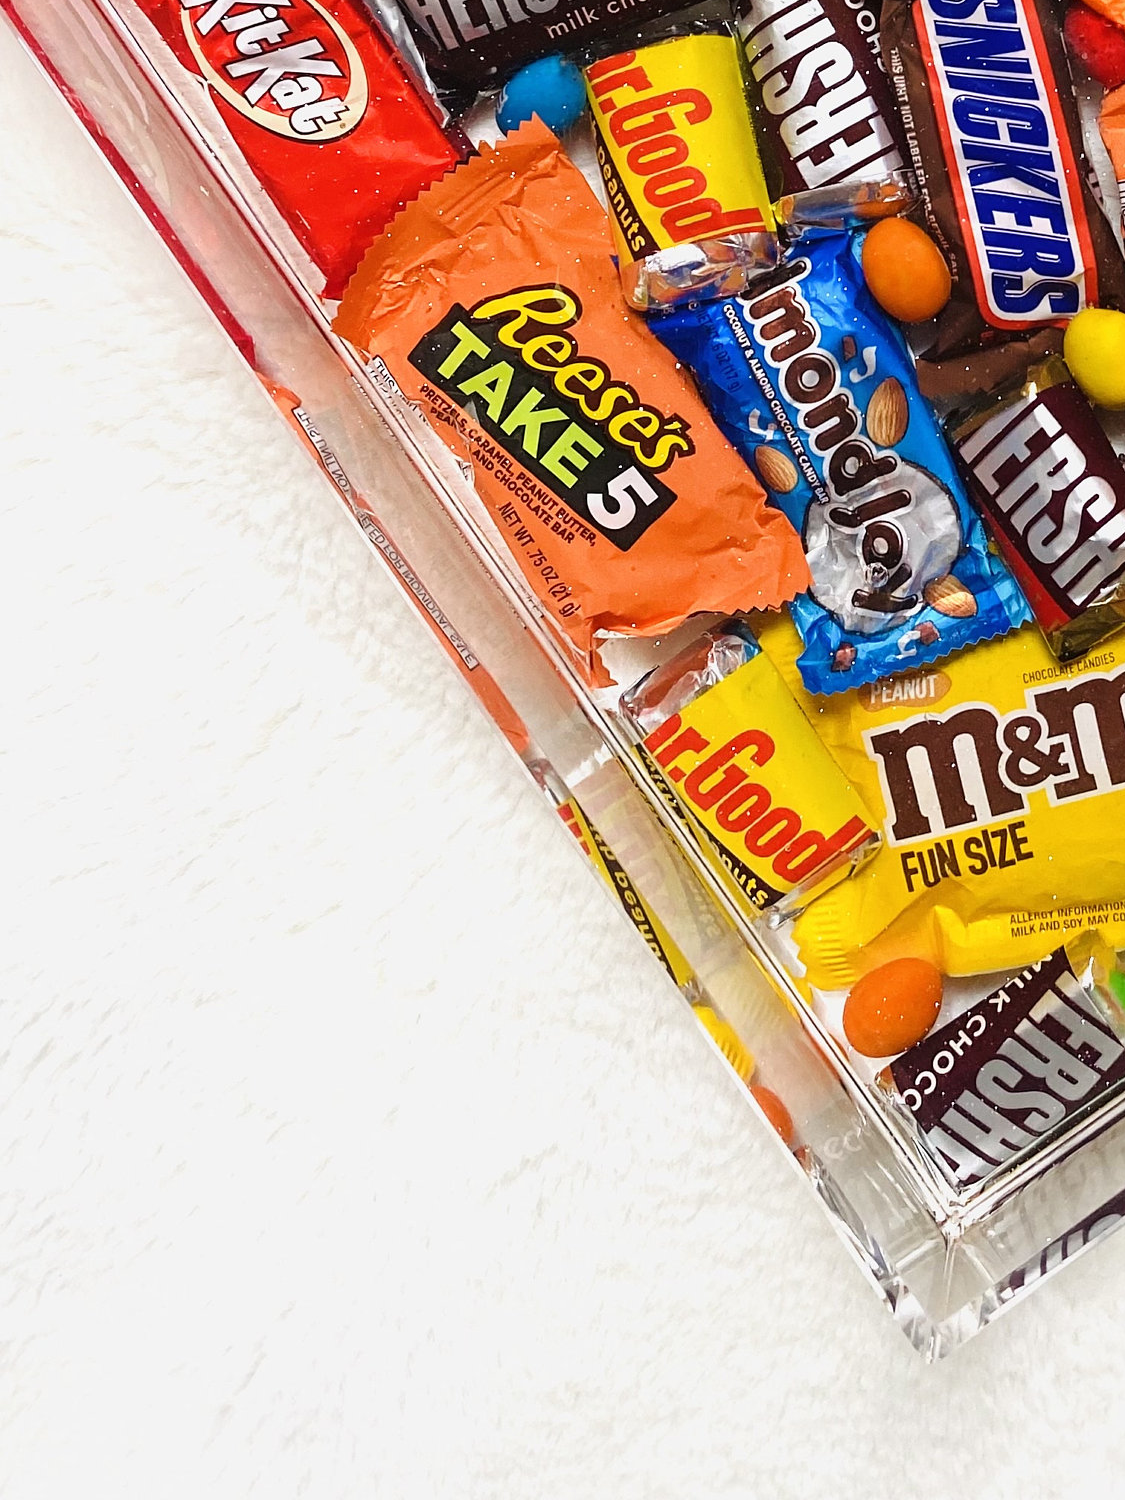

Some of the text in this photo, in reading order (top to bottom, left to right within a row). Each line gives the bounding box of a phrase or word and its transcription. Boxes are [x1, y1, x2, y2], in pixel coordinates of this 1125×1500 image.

[545, 7, 600, 40] milk
[598, 150, 645, 253] peanuts
[470, 286, 692, 470] Reese's
[724, 305, 823, 491] COCONUT ALMOND CHOCOLATE CANDY
[739, 259, 896, 494] lmond
[419, 385, 597, 547] PRETZELS, CARAMEL, PEANUT BUTTER,
[436, 320, 659, 530] TAKE 5
[472, 447, 576, 545] AND CHOCOLATE BAR
[499, 502, 560, 588] NET WT OZ
[870, 675, 938, 704] PEANUT
[1022, 652, 1116, 684] CHOCOLATE CANDIES
[901, 821, 1033, 892] FUN SIZE
[1010, 910, 1053, 924] ALLERGY
[1011, 923, 1036, 938] MILK
[1040, 920, 1060, 932] AND
[1088, 914, 1109, 926] MAY
